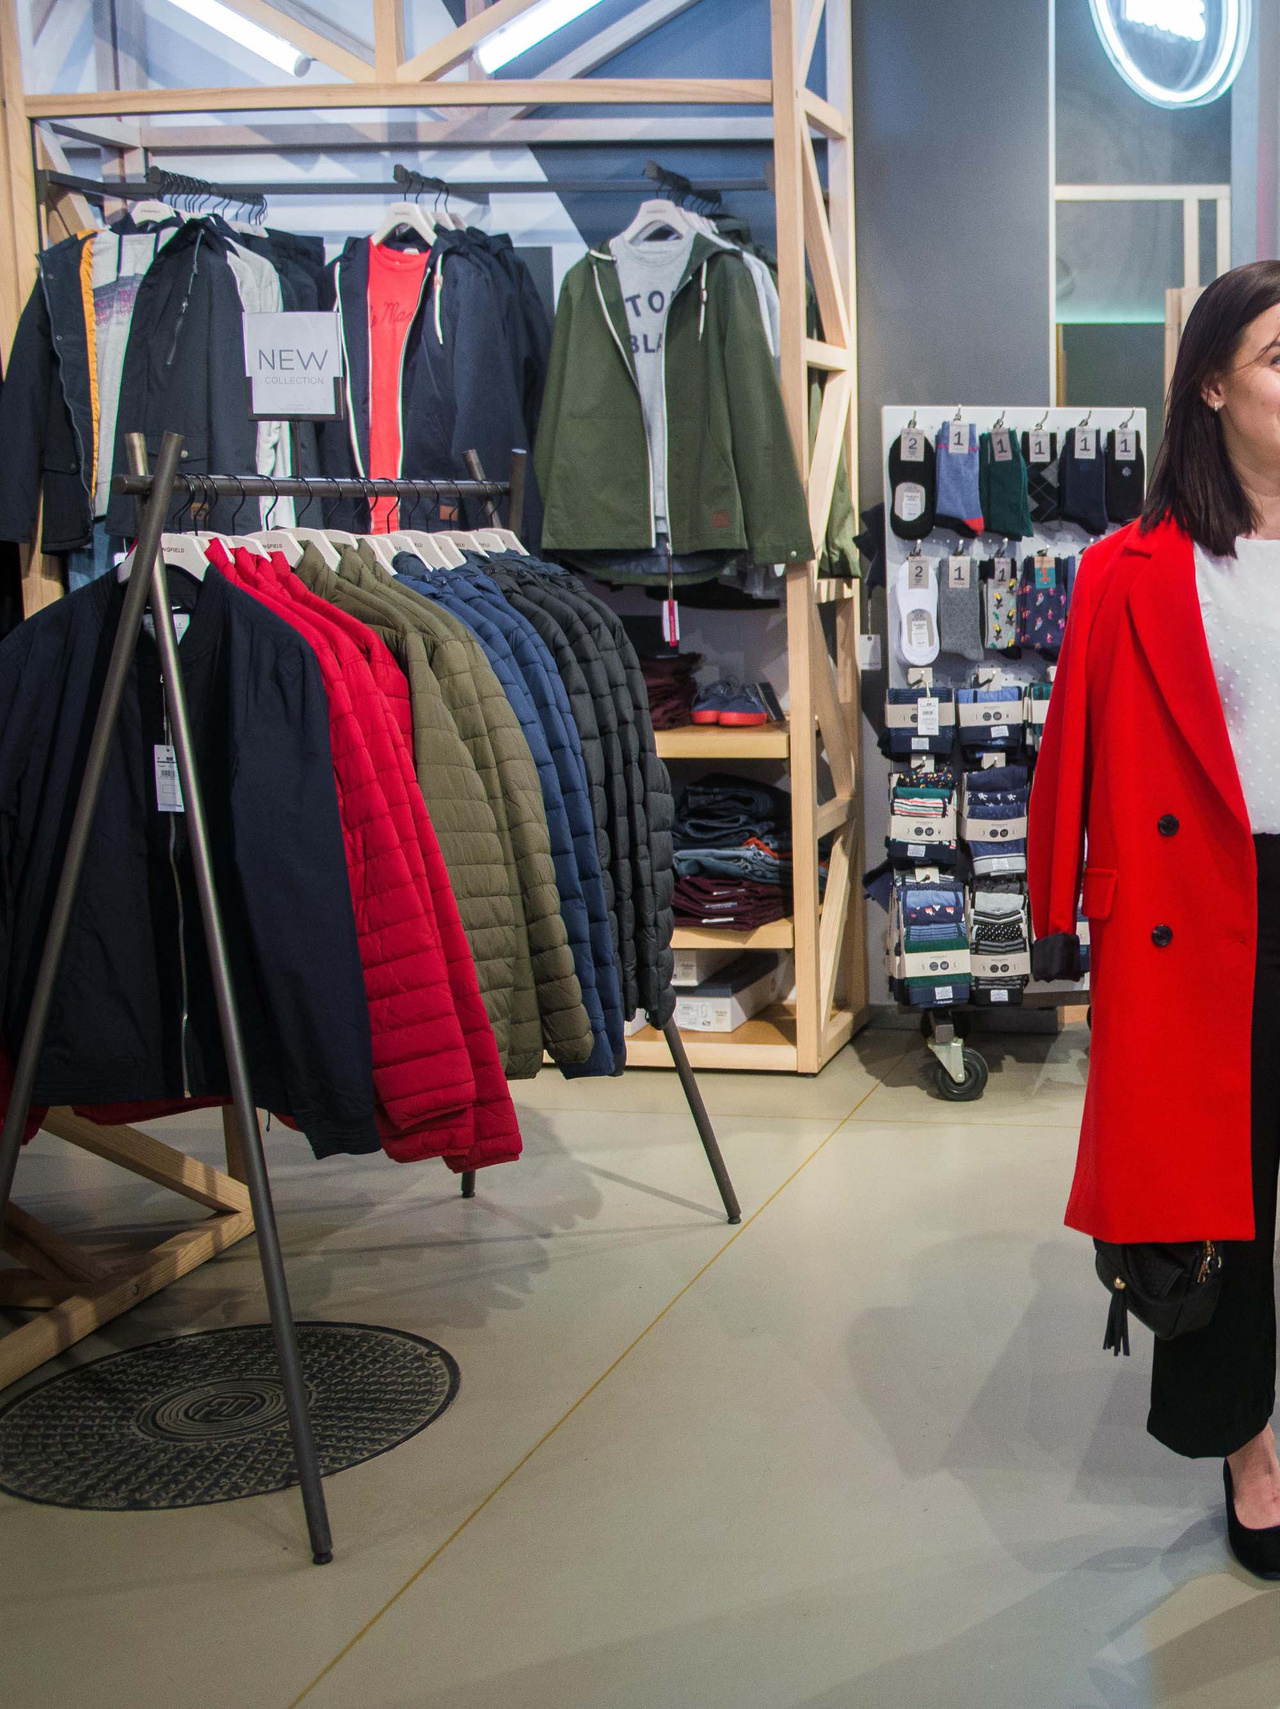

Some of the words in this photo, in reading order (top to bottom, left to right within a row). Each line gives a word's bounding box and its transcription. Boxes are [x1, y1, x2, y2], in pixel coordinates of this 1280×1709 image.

[625, 290, 676, 317] TO
[258, 349, 328, 371] NEW
[264, 376, 324, 385] COLLECTION
[908, 437, 918, 450] 2
[953, 431, 964, 446] 1
[996, 438, 1008, 454] 1
[1080, 436, 1091, 452] 1
[1120, 438, 1131, 453] 1
[1034, 440, 1045, 455] 1
[914, 565, 923, 578] 2
[954, 566, 965, 581] 1
[997, 567, 1006, 582] 1
